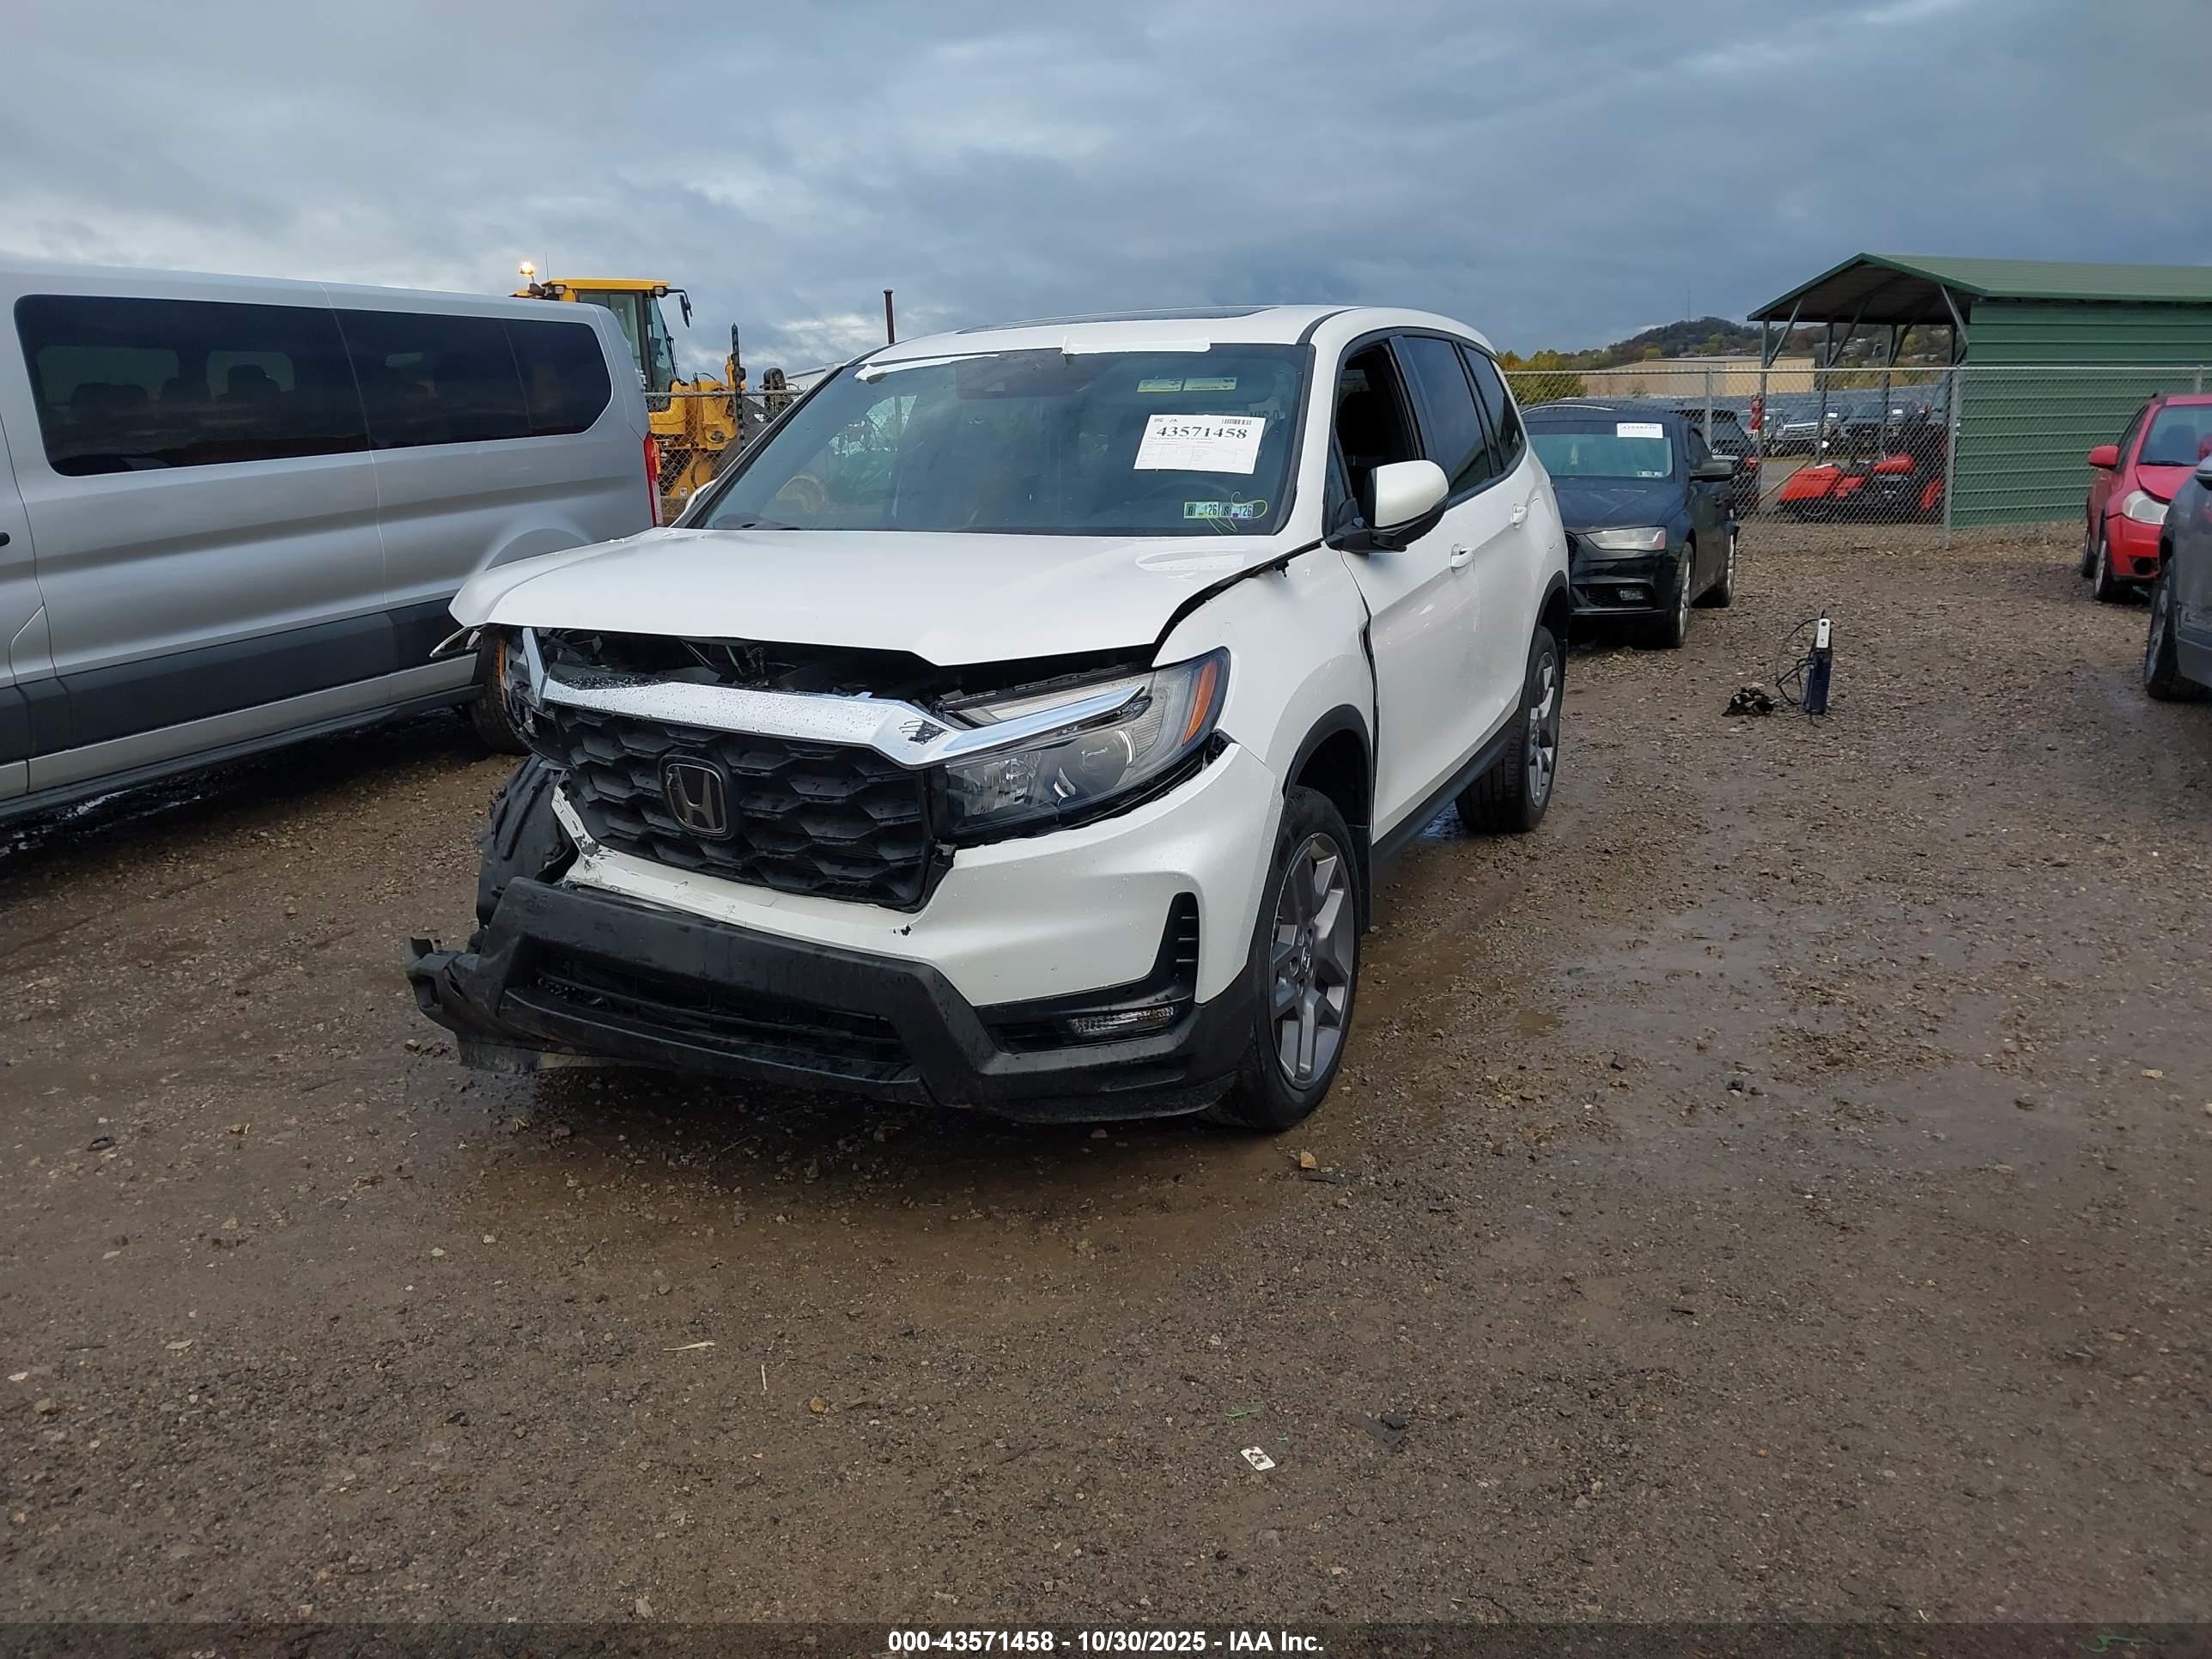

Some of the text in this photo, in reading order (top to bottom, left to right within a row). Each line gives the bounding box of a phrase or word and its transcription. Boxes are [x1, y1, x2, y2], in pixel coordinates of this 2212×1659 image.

[1156, 426, 1248, 440] 43571458
[1207, 503, 1218, 516] 26
[1243, 505, 1253, 517] 26
